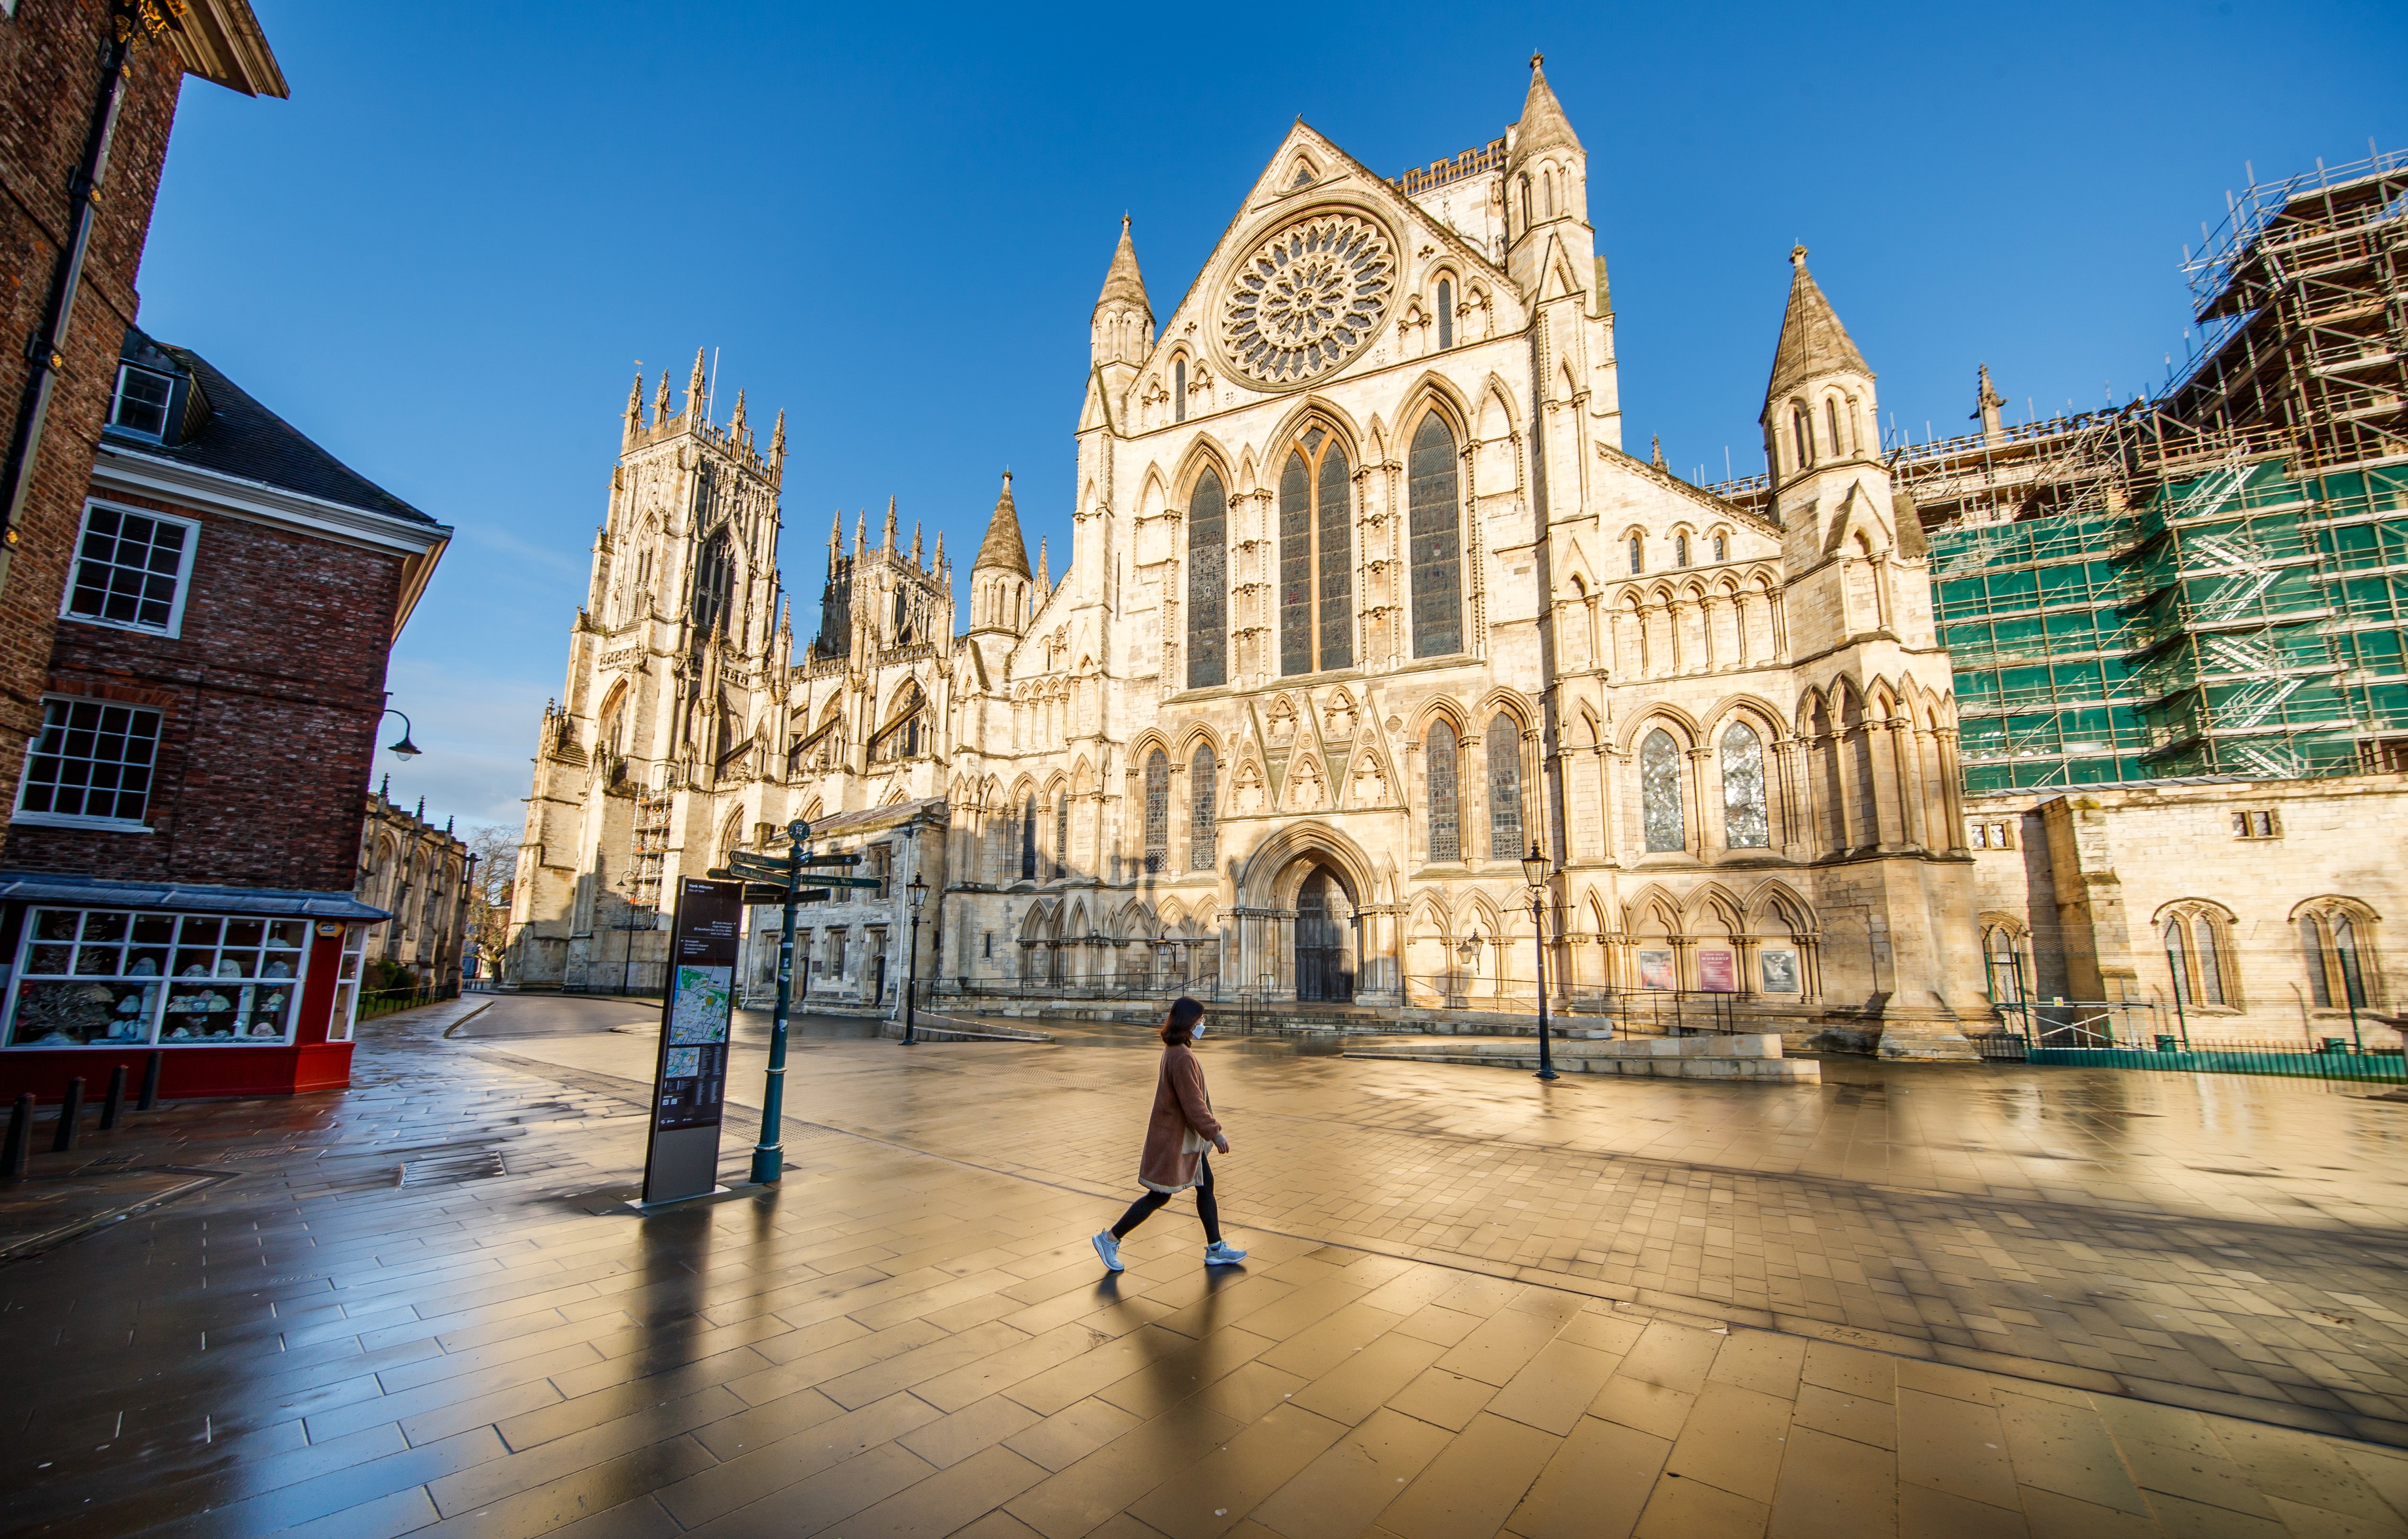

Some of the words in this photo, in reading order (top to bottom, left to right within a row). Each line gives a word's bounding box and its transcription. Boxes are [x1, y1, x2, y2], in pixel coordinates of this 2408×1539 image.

[746, 855, 769, 865] Shambles
[732, 866, 748, 875] Castle
[749, 870, 761, 879] Area
[803, 876, 838, 885] Centenary
